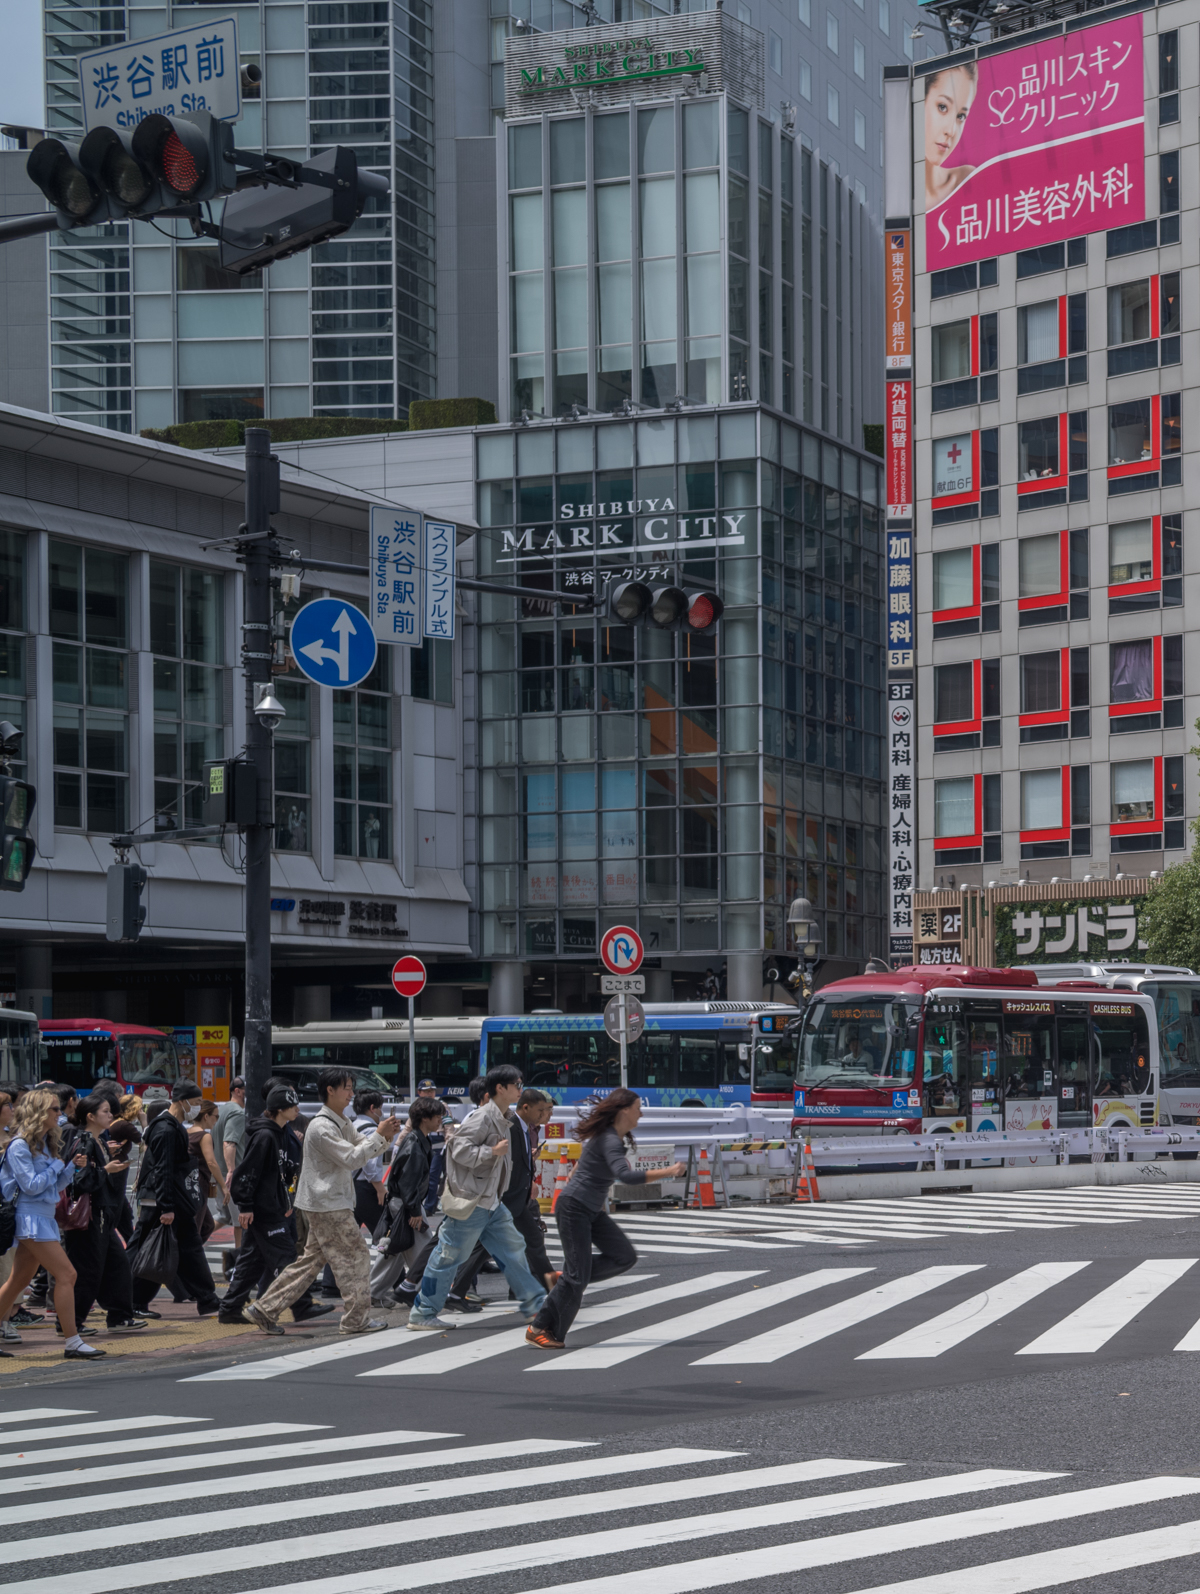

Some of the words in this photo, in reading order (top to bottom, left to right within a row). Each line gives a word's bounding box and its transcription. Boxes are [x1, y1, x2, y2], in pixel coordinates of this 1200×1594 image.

[564, 38, 652, 58] SHIBUYA
[93, 34, 224, 110] 渋谷駅前
[520, 59, 611, 86] MARK
[622, 48, 700, 72] CITY
[1018, 41, 1132, 99] 品川スキン
[181, 93, 212, 114] Sta.
[1019, 80, 1120, 134] クリニック
[956, 163, 1134, 246] 品川美容外科
[891, 252, 906, 352] 東京スター銀行
[891, 357, 906, 367] 8F
[891, 382, 907, 448] 外貨両替
[560, 498, 675, 519] SHIBUYA
[892, 505, 907, 516] 7F
[500, 523, 624, 553] MARK
[643, 514, 746, 541] CITY
[377, 534, 391, 588] Shibuya
[392, 519, 416, 635] 渋谷駅前
[431, 526, 449, 635] スクランブル式
[889, 536, 911, 643] 加藤眼科
[377, 594, 391, 619] Sta.
[890, 652, 910, 666] 5F
[891, 685, 911, 700] 3F
[892, 731, 911, 766] 内科
[270, 899, 295, 911] EIO
[349, 900, 397, 922] 渋谷駅
[920, 912, 938, 937] 薬
[942, 914, 962, 933] 2F
[1011, 904, 1150, 956] サンドラ
[535, 932, 567, 944] MAK
[919, 946, 962, 965] 処方せん
[605, 980, 642, 991] ここまで
[1006, 1002, 1051, 1012] キャッシュレスバス
[1093, 1004, 1120, 1014] CASHLESS
[1121, 1005, 1132, 1014] BUS
[202, 1030, 224, 1040] 宝くじ
[447, 1087, 466, 1095] KEIO
[548, 1124, 561, 1138] 注
[634, 1160, 671, 1168] はいっては
